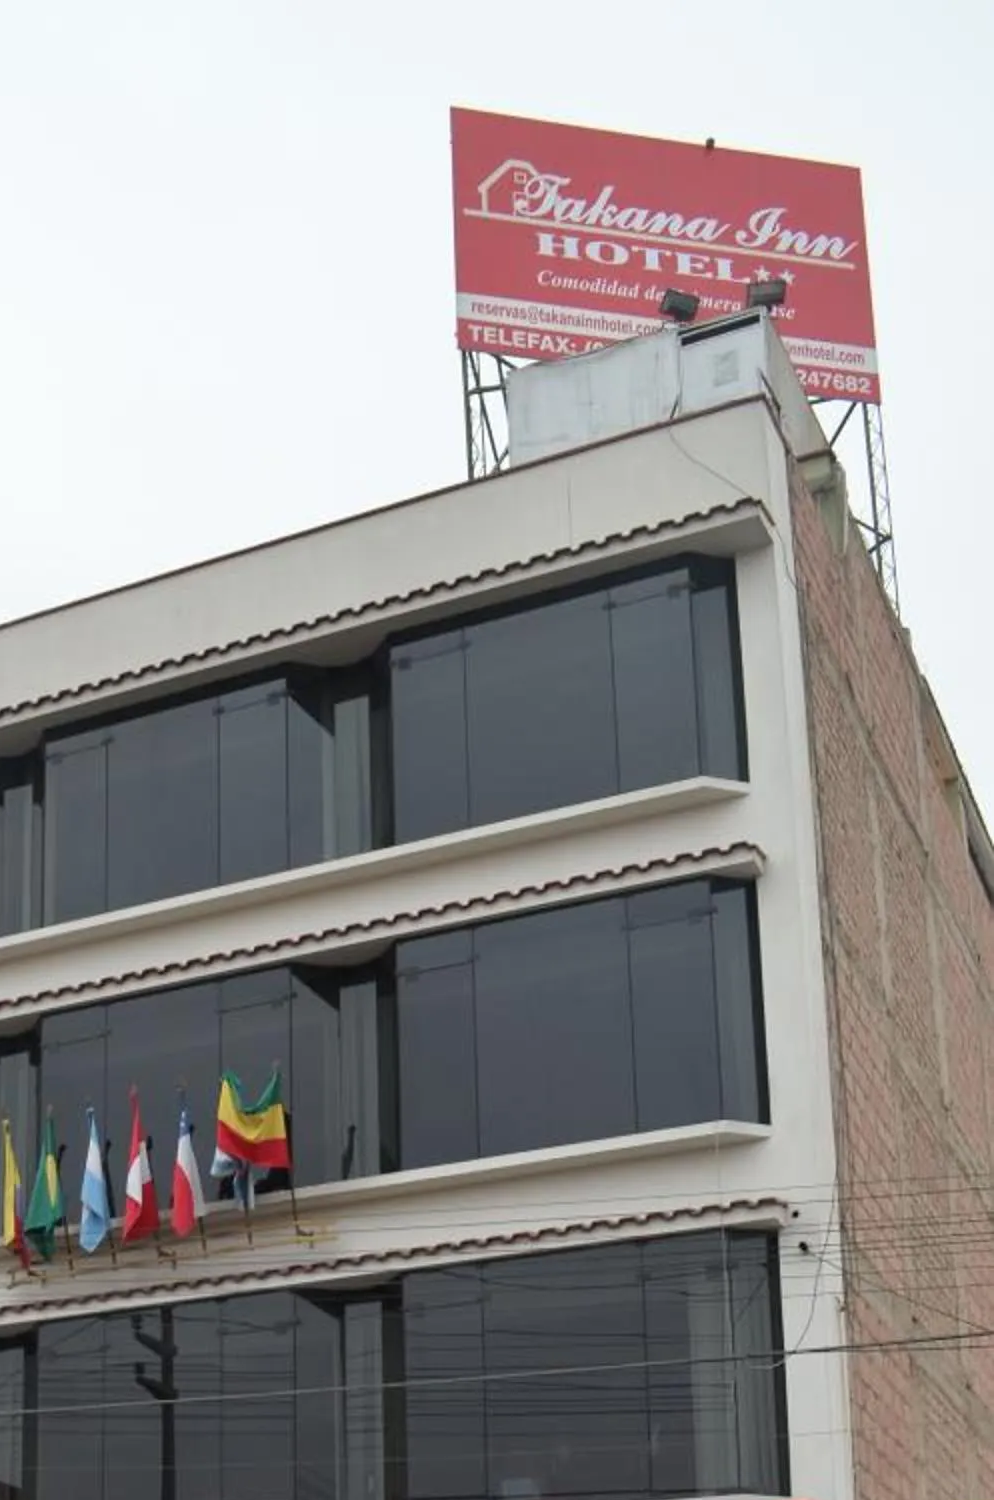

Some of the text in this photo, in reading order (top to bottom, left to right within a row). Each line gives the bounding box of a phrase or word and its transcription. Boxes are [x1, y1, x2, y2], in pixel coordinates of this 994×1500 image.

[516, 173, 859, 260] Takana Inn
[536, 232, 750, 285] HOTEL
[537, 269, 639, 300] Comodidad
[467, 323, 576, 355] TELEFAX:
